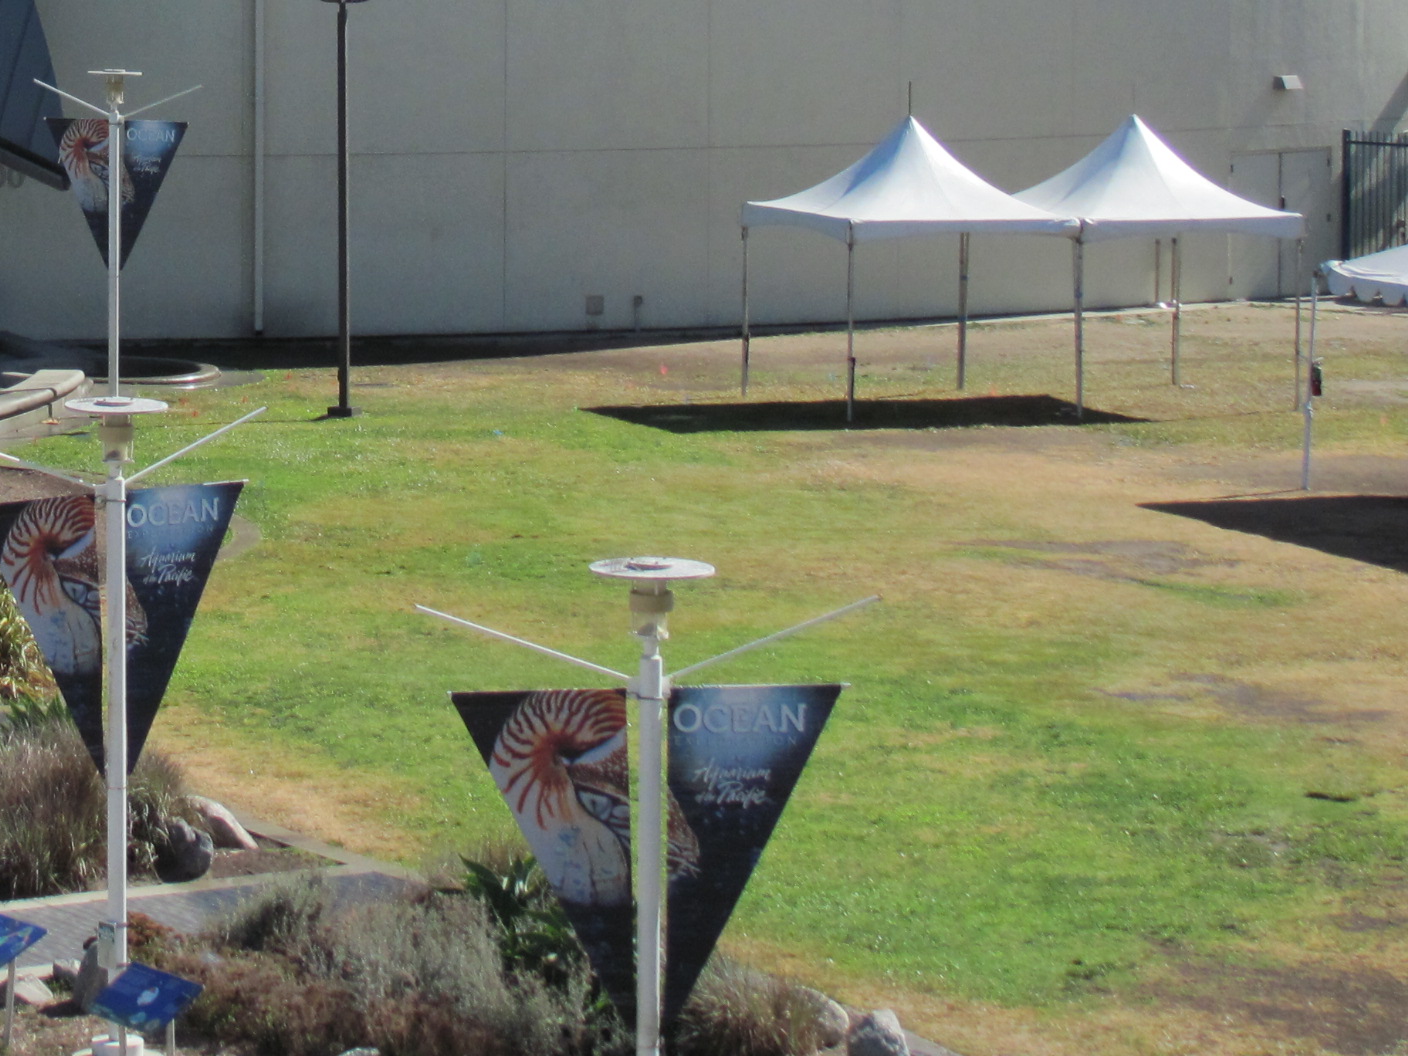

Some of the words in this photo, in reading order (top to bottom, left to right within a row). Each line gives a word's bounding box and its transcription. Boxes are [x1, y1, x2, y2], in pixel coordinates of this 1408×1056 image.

[126, 127, 176, 143] OCEAN
[127, 497, 220, 527] OCEAN
[673, 703, 807, 733] OCEAN
